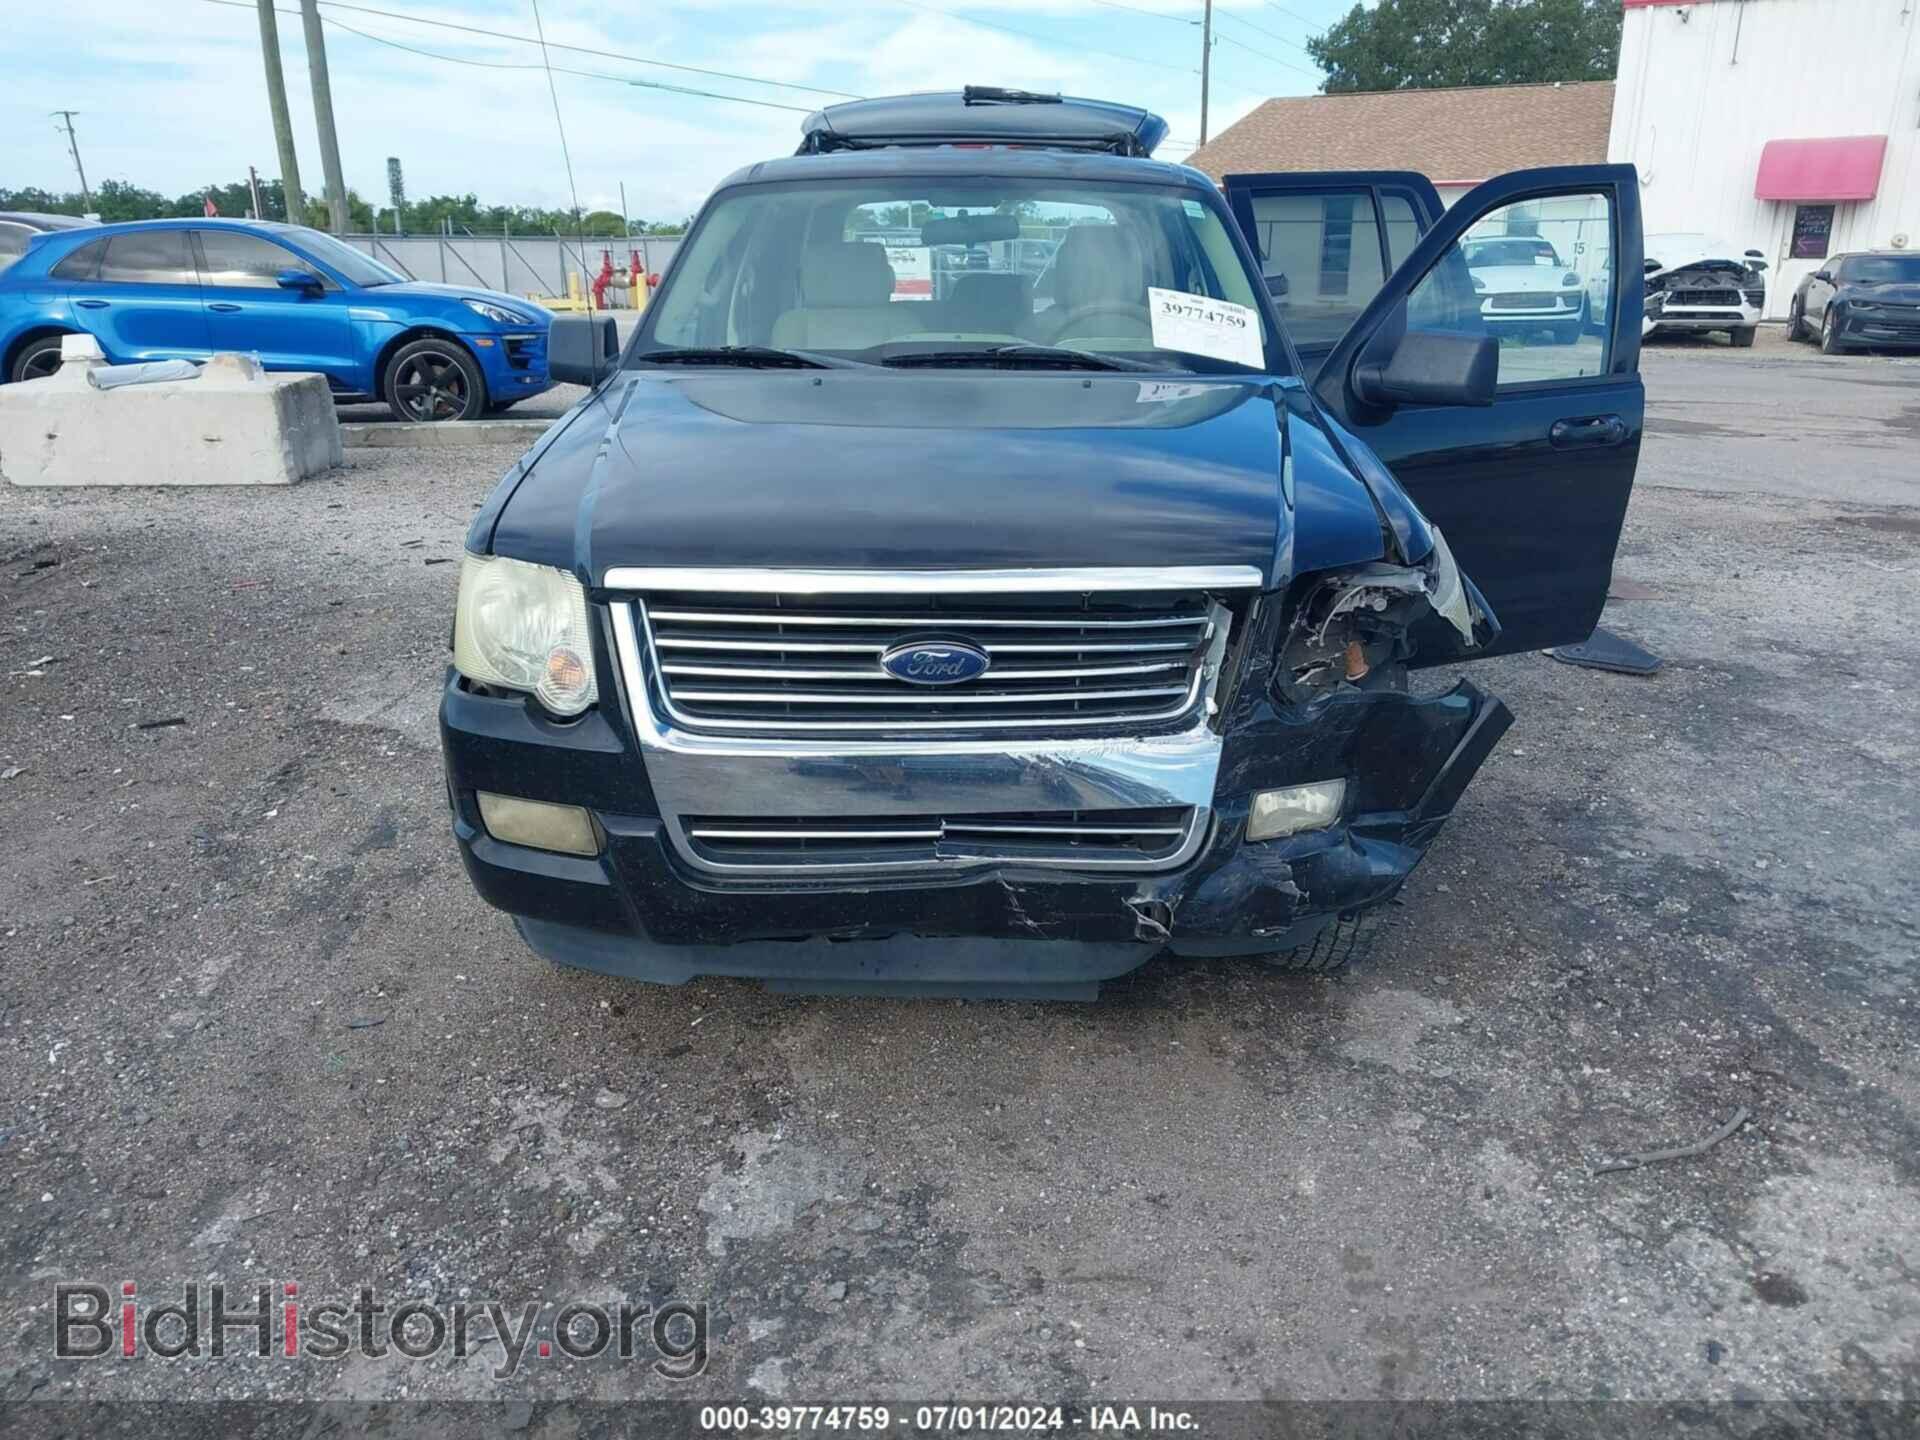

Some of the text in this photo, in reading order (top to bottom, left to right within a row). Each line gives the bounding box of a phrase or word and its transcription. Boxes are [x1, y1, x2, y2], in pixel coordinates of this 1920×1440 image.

[1574, 242, 1585, 255] 15
[1161, 302, 1246, 329] 39774759
[907, 651, 966, 676] Ford
